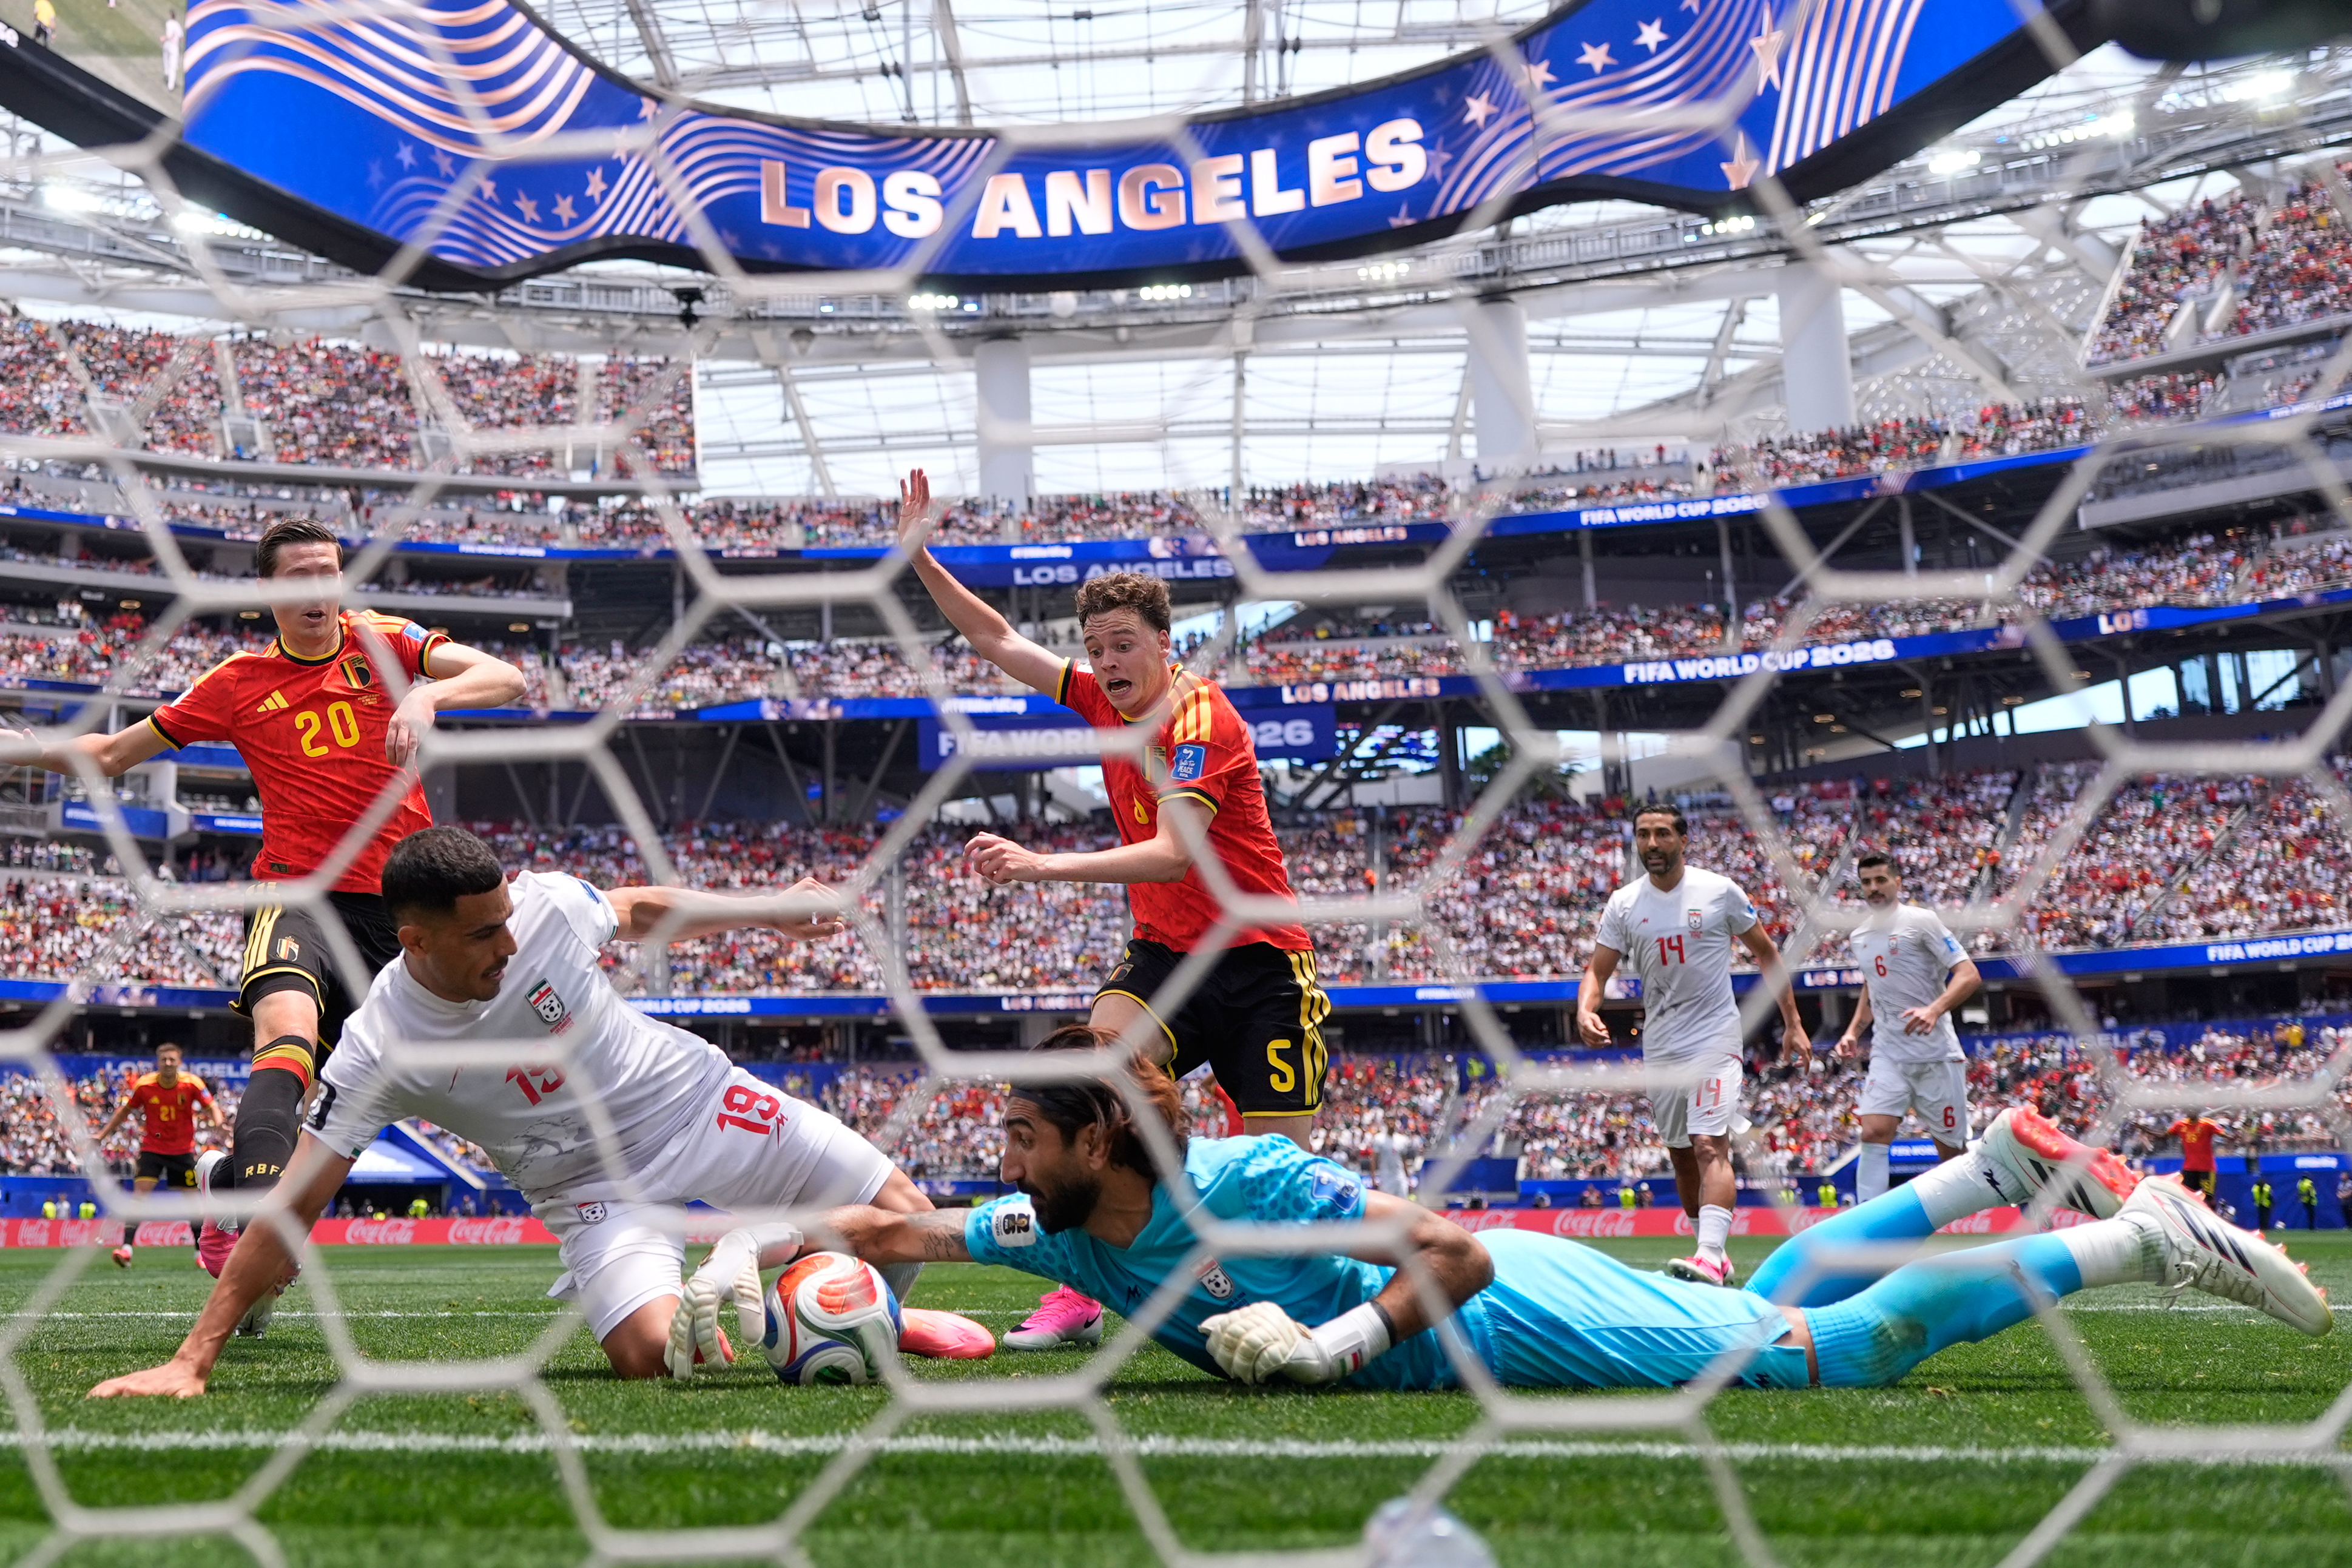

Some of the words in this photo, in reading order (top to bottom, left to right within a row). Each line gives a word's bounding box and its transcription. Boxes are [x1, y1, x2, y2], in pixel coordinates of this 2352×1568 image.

[760, 158, 944, 240] LOS
[971, 117, 1428, 240] ANGELES
[1579, 510, 1618, 526] FIFA
[1616, 504, 1677, 522] WORLD
[1677, 500, 1711, 517] CUP
[1711, 493, 1770, 515] 2026
[1295, 530, 1329, 547] LOS
[1331, 526, 1407, 544] ANGELES
[1013, 565, 1079, 585] LOS
[1623, 664, 1676, 684] FIFA
[1674, 654, 1759, 681] WORLD
[1761, 649, 1810, 673] CUP
[1810, 639, 1896, 667] 2026
[1281, 682, 1330, 704] LOS
[1332, 678, 1441, 701] ANGELES
[294, 700, 360, 758] 20
[1009, 728, 1100, 757] WORL
[1247, 719, 1315, 747] 26
[1656, 935, 1685, 966] 14
[2206, 944, 2246, 961] FIFA
[2245, 938, 2302, 959] WORLD
[2302, 935, 2335, 954] CUP
[1875, 955, 1887, 977] 6
[1696, 1077, 1721, 1107] 14
[160, 1105, 176, 1122] 21
[1943, 1106, 1956, 1128] 6
[345, 1219, 416, 1245] Coca-Cola
[448, 1218, 524, 1245] Coca-Cola
[1552, 1208, 1637, 1237] Coca-Cola
